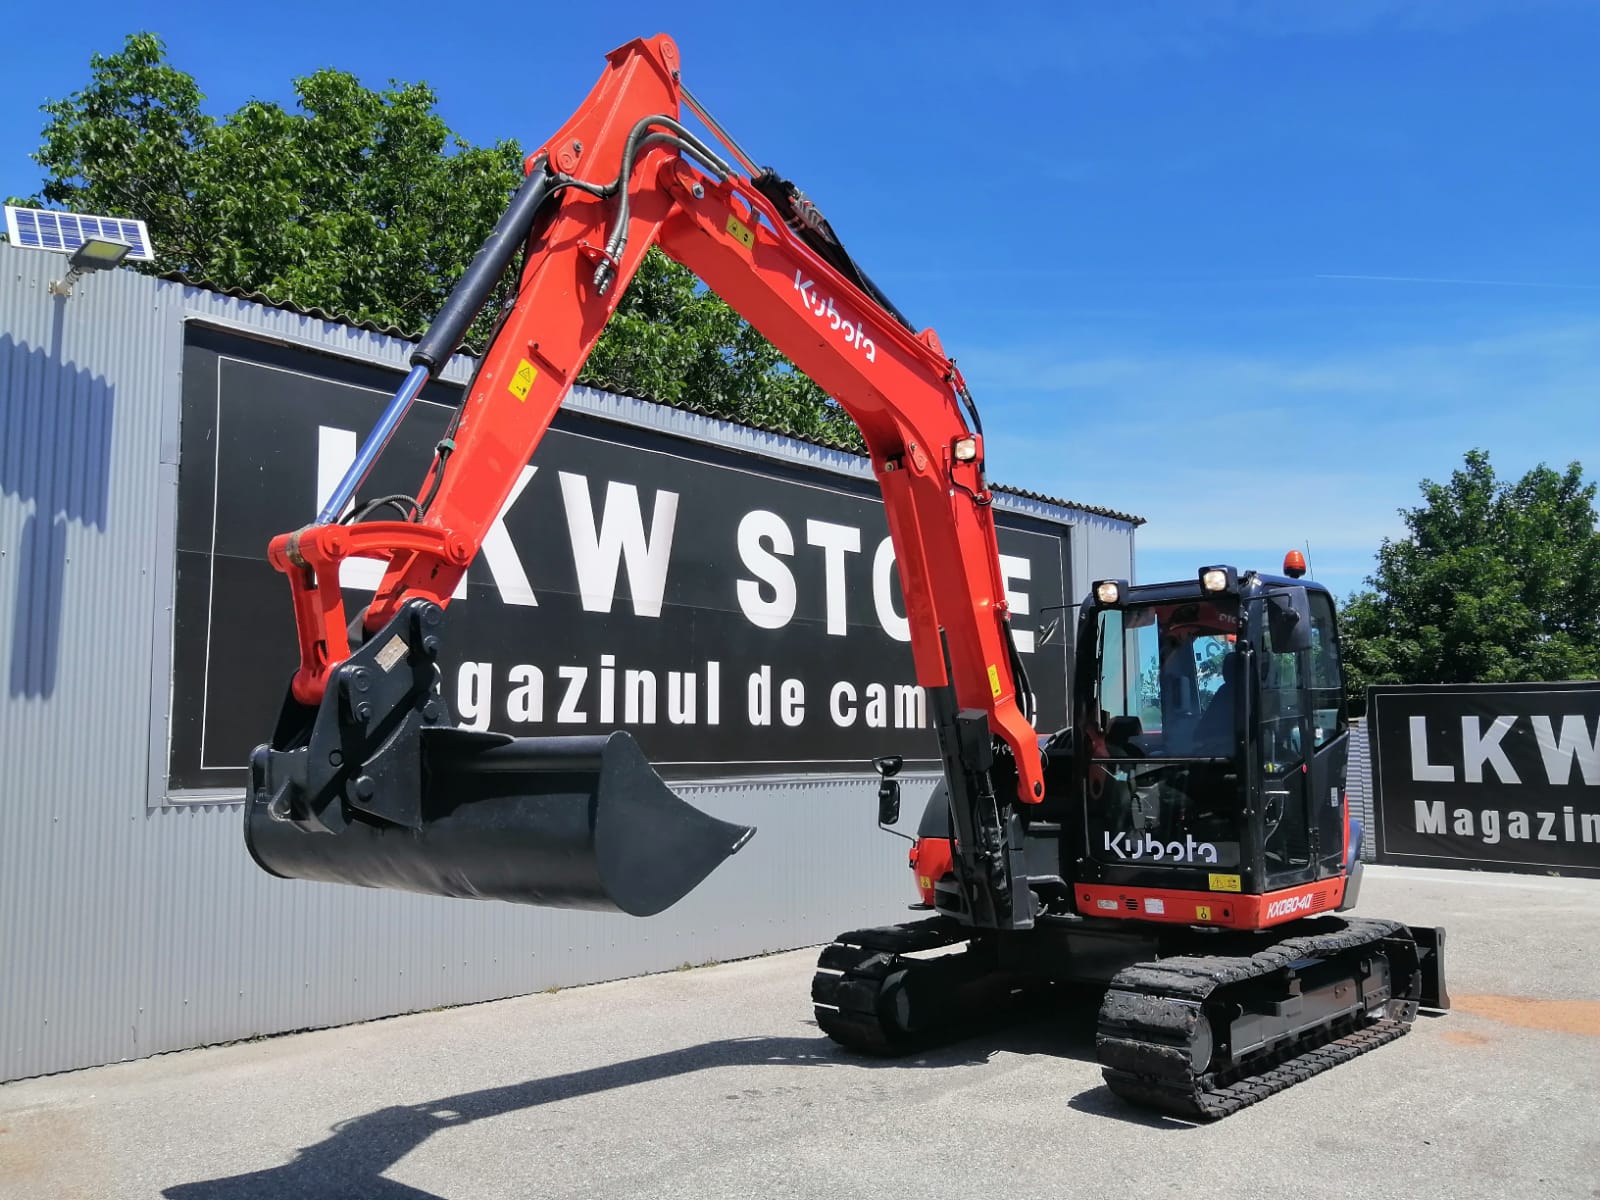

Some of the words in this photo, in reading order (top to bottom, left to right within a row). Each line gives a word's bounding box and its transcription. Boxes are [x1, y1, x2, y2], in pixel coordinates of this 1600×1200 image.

[793, 270, 876, 363] Kubota
[736, 510, 1035, 653] STOE
[433, 653, 721, 732] gazinul
[747, 664, 806, 727] de
[1409, 714, 1600, 786] LKW
[1103, 830, 1218, 863] Kubota
[1414, 799, 1600, 844] Magazin
